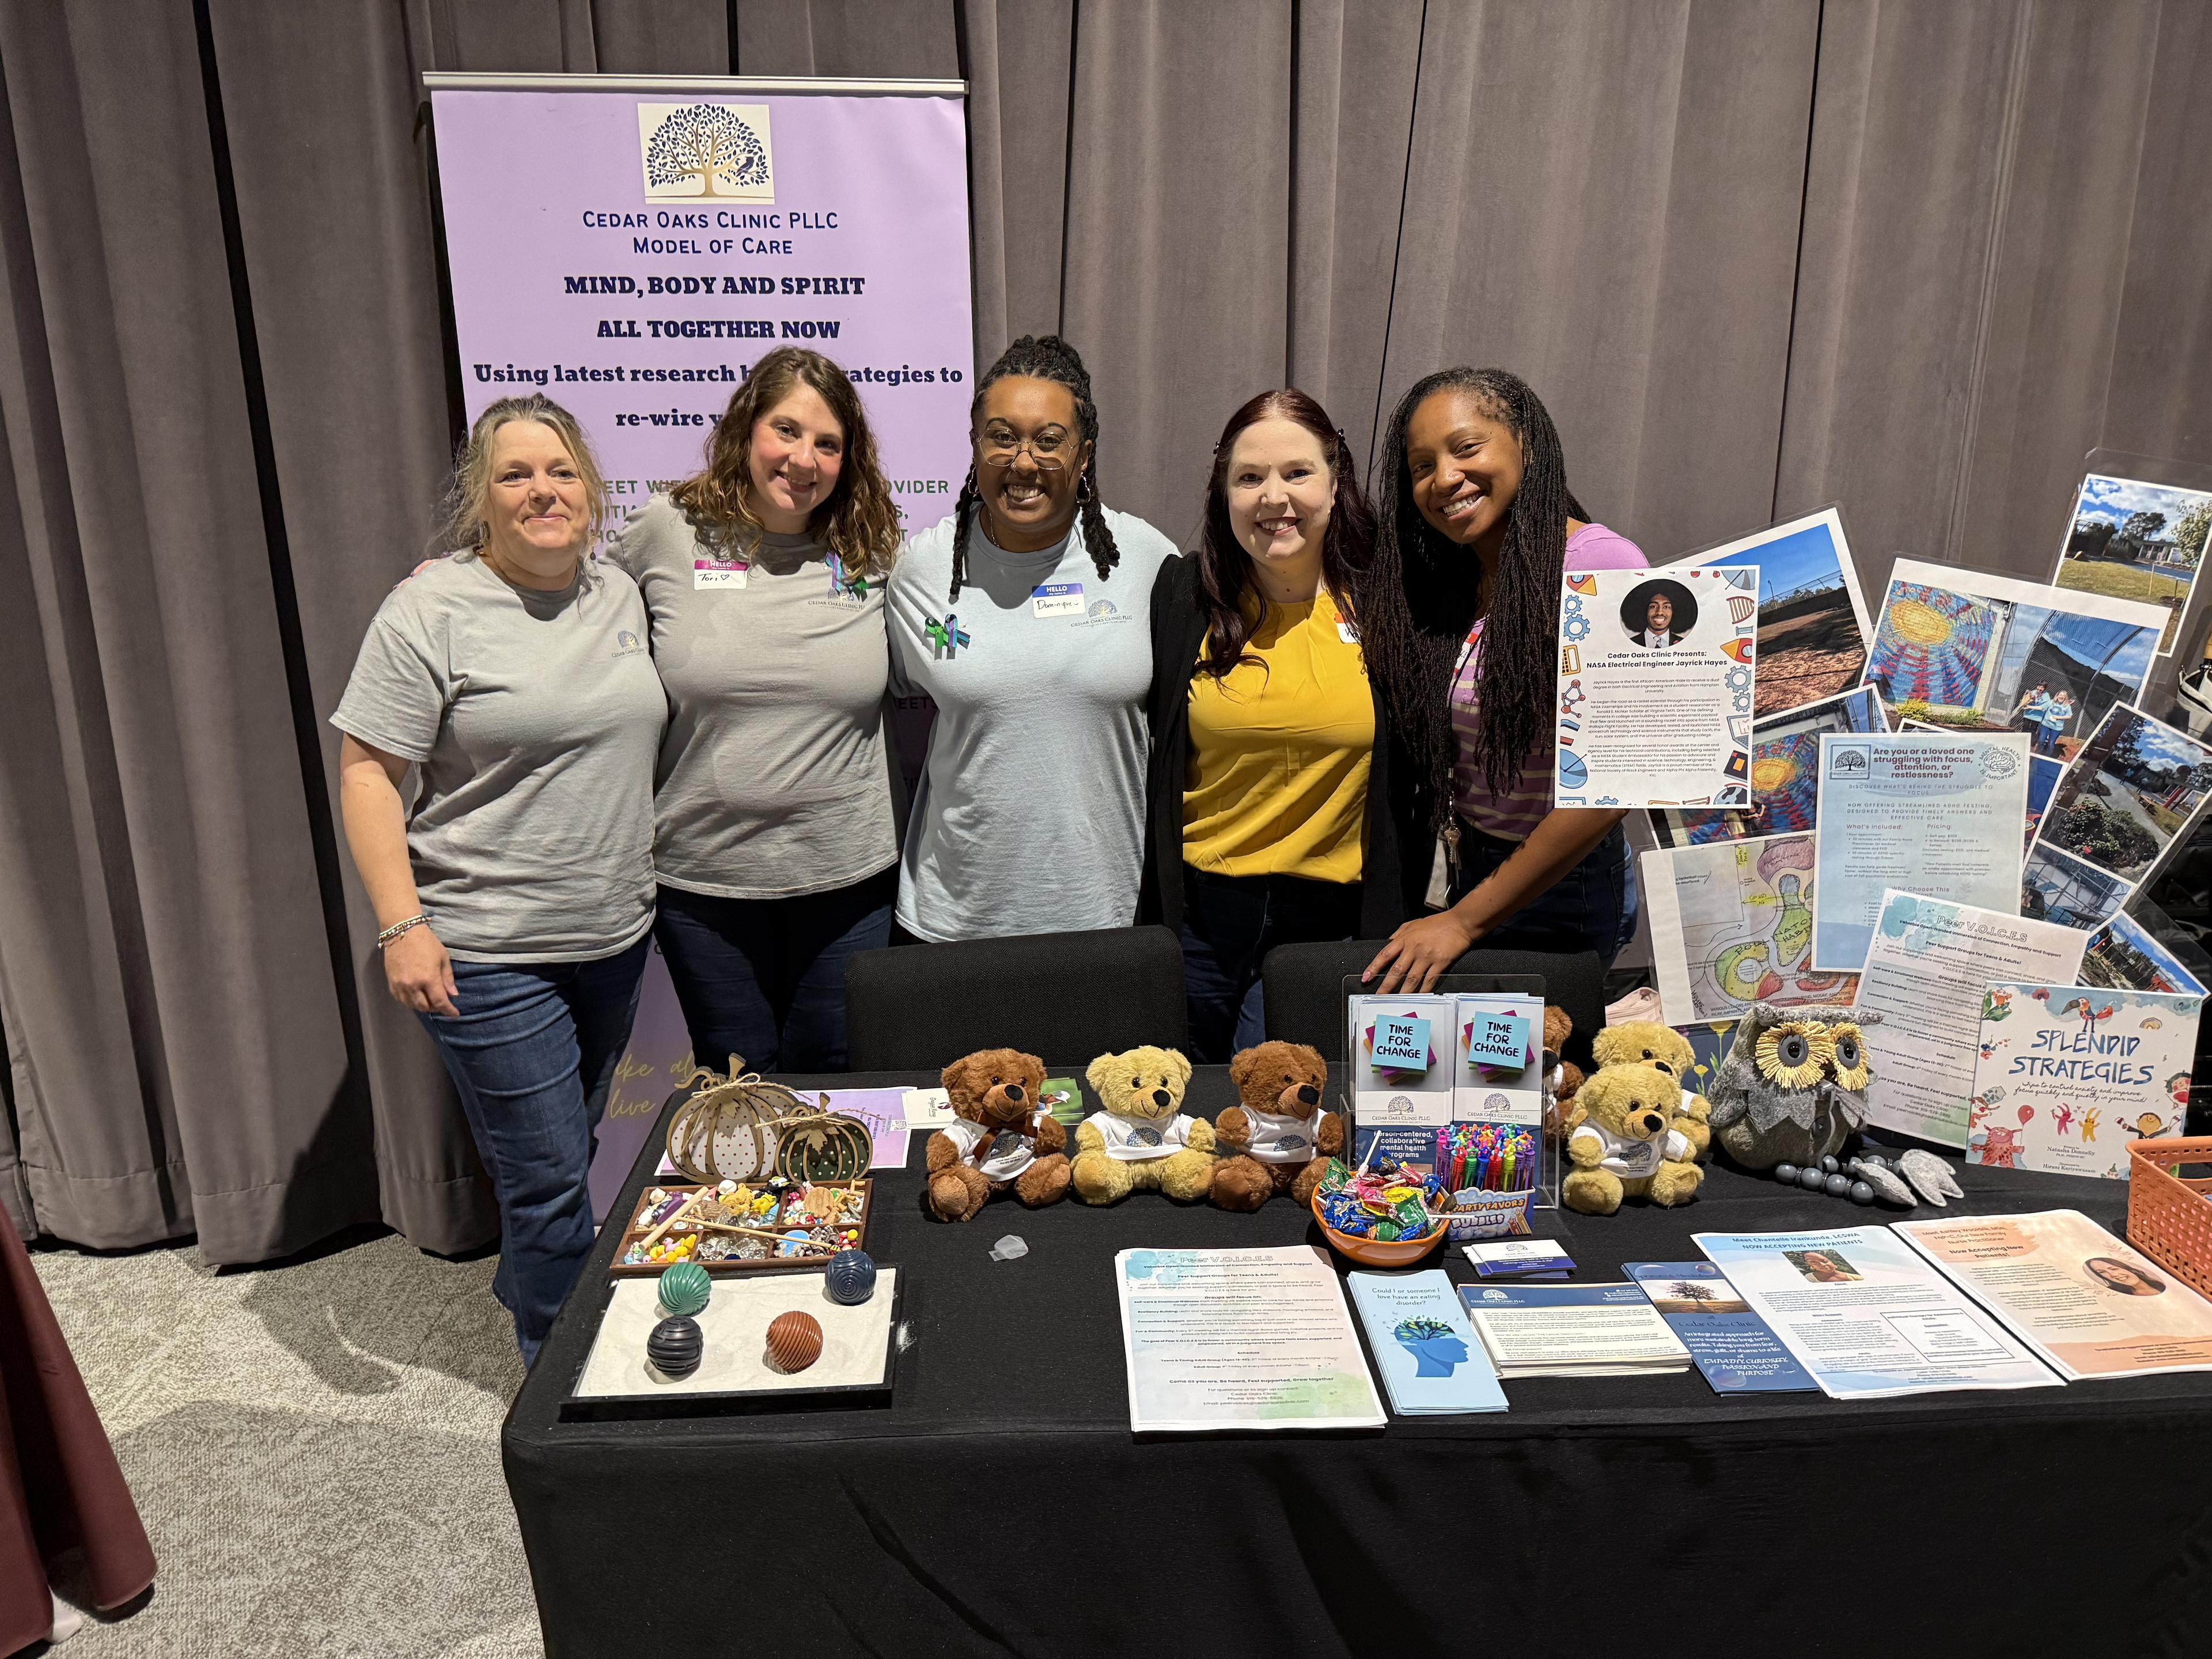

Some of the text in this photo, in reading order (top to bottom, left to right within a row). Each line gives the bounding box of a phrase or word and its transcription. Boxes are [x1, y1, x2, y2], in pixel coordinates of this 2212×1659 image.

[789, 212, 838, 229] PLLC
[564, 276, 865, 298] MIND, BODY AND SPIRIT
[597, 320, 840, 339] ALL TOGETHER NOW
[474, 363, 548, 385] Using
[553, 365, 624, 382] latest
[630, 365, 737, 382] research
[847, 365, 935, 387] ategies
[940, 366, 963, 383] to
[616, 408, 704, 426] re-wire
[889, 480, 949, 494] VIDER
[698, 573, 718, 581] Tori
[1037, 600, 1073, 610] Dominique
[1676, 660, 1703, 668] Jayrick
[1873, 756, 1921, 764] struggling
[1945, 756, 1973, 764] focus,
[1891, 749, 1908, 757] you
[1979, 746, 2021, 760] MENTAL HEALTH
[1986, 769, 2018, 781] IMPORTANT
[1937, 915, 1964, 929] Peer
[1925, 940, 1937, 948] Peer
[1937, 942, 1957, 952] Support
[1957, 948, 1976, 956] Groups
[1983, 953, 1999, 961] Teens
[2003, 957, 2022, 965] Adults!
[1389, 1024, 1414, 1036] TIME
[1487, 1021, 1512, 1033] TIME
[1388, 1036, 1411, 1047] FOR
[1486, 1033, 1509, 1045] FOR
[2031, 1029, 2141, 1056] SPLENDID
[1376, 1046, 1421, 1059] CHANGE
[1474, 1043, 1520, 1058] CHANGE
[2008, 1056, 2154, 1085] STRATEGIES
[2013, 1086, 2034, 1096] focus
[2035, 1089, 2061, 1099] quickly
[1453, 1198, 1526, 1213] PARTY FAVORS
[1451, 1214, 1505, 1229] BUBBLES
[1968, 1245, 2006, 1253] Accepting
